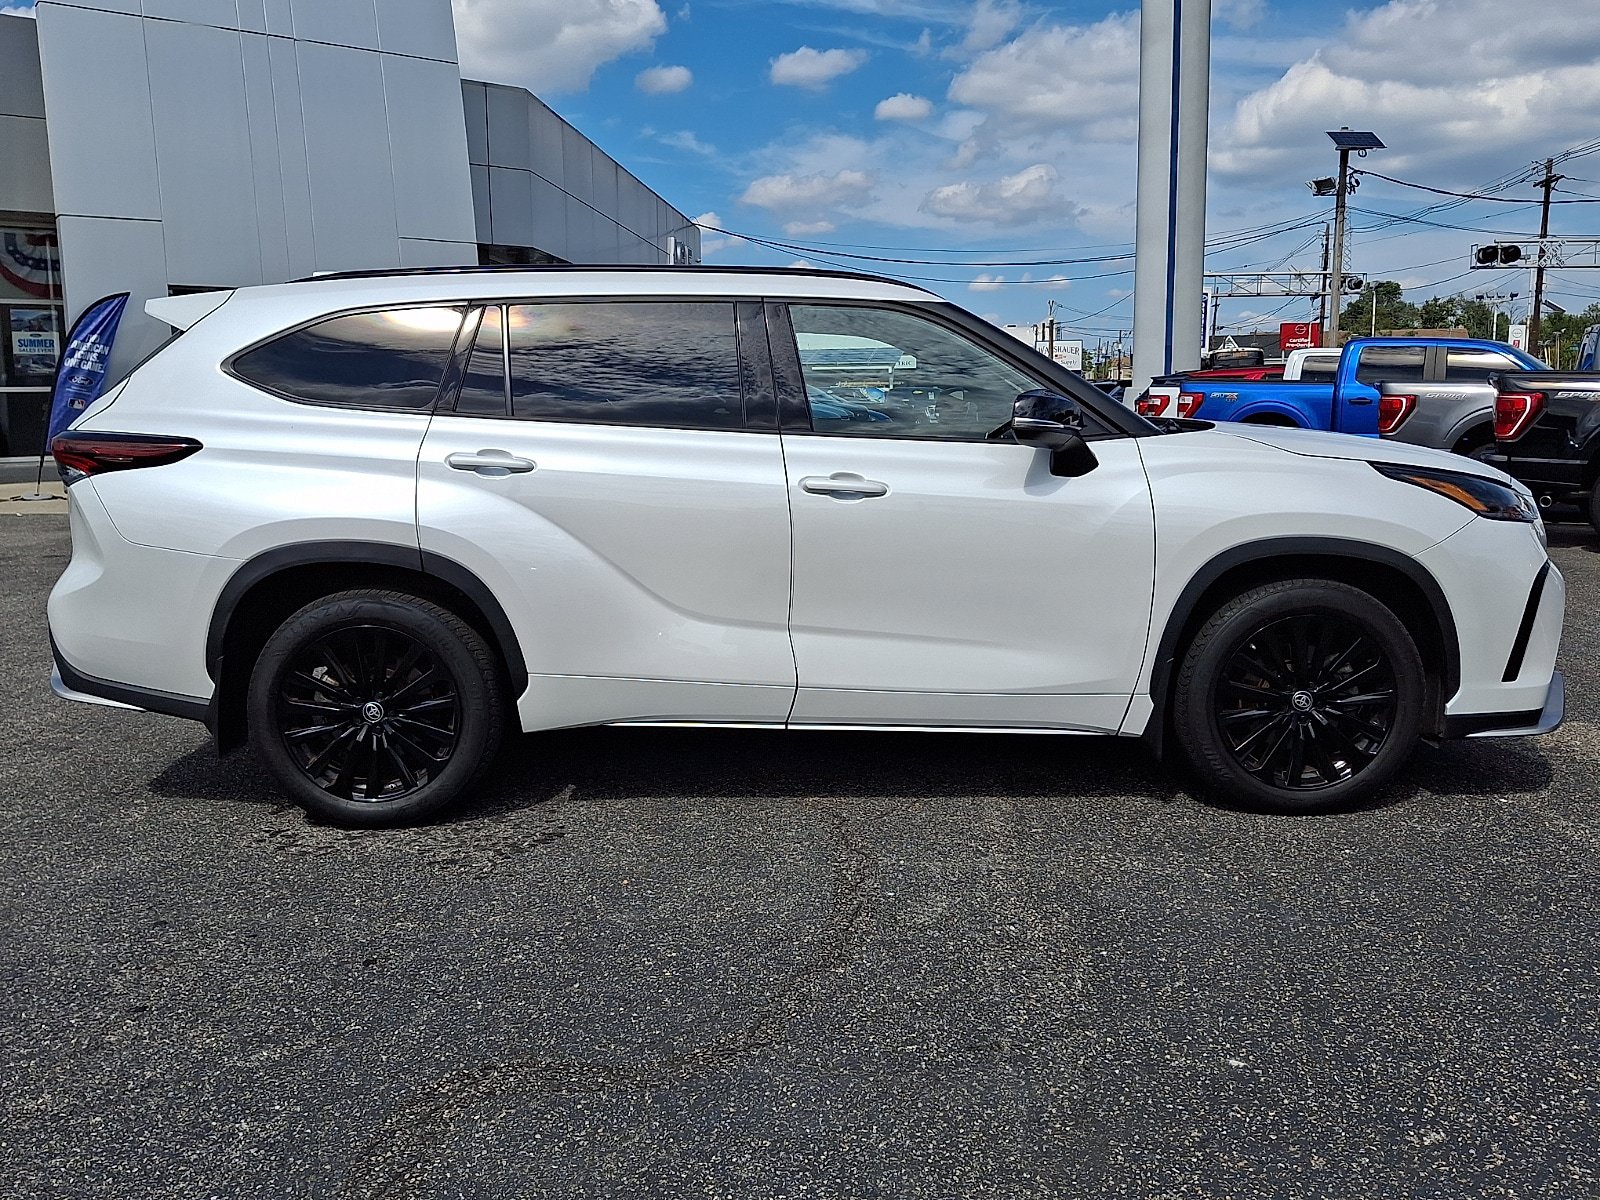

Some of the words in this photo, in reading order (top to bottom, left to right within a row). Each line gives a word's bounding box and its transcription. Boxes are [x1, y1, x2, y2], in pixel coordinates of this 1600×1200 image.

[17, 339, 55, 348] SUMMER
[70, 340, 110, 355] AMERICAN
[1038, 345, 1080, 356] WASHAUER
[64, 357, 80, 369] ONE
